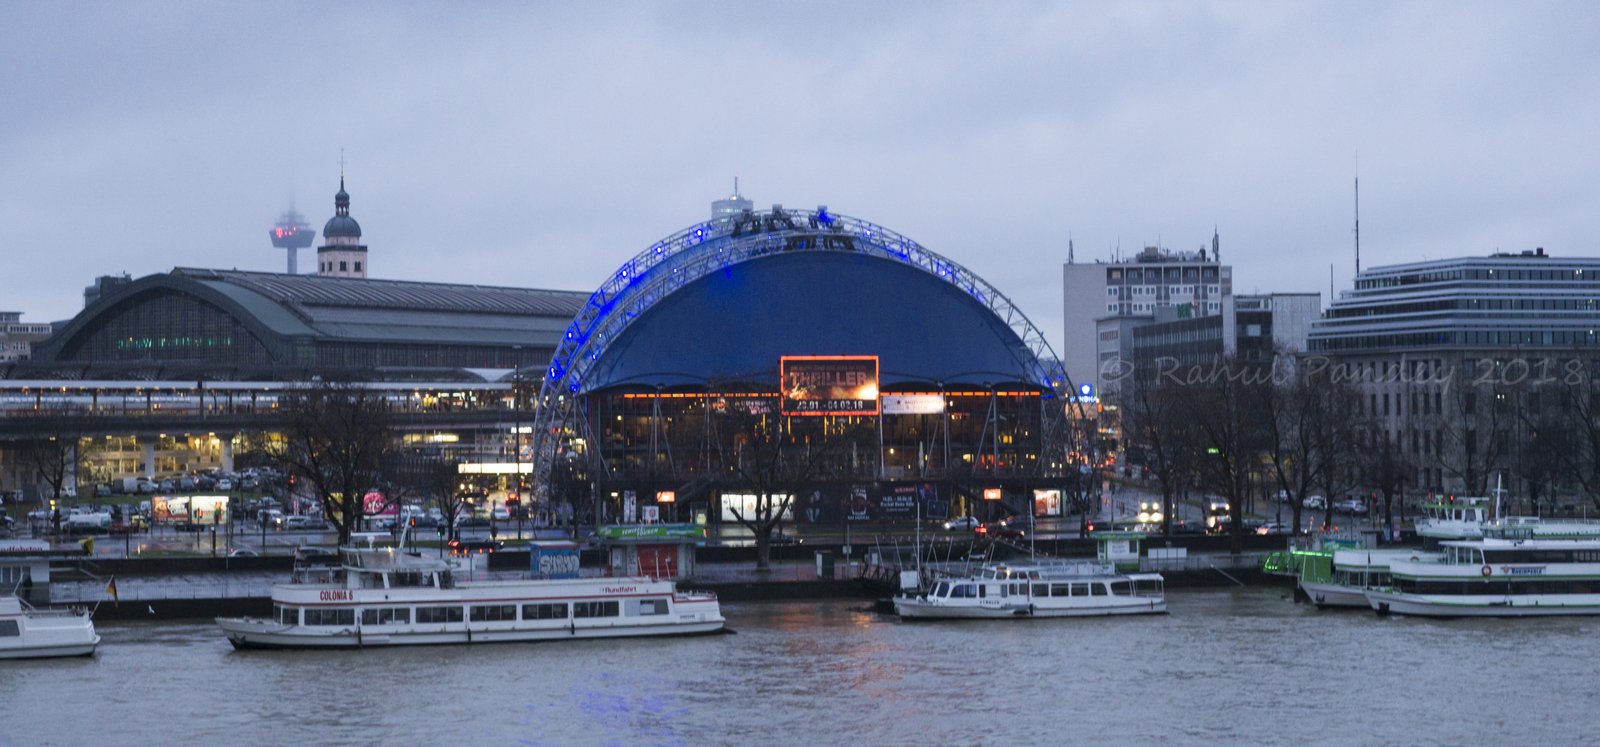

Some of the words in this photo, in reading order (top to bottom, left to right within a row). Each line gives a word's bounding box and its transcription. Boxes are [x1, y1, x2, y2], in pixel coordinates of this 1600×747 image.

[789, 371, 867, 386] THRILLER
[604, 585, 637, 594] Rundfahrt
[320, 590, 347, 601] COLONIA
[348, 590, 354, 601] 6
